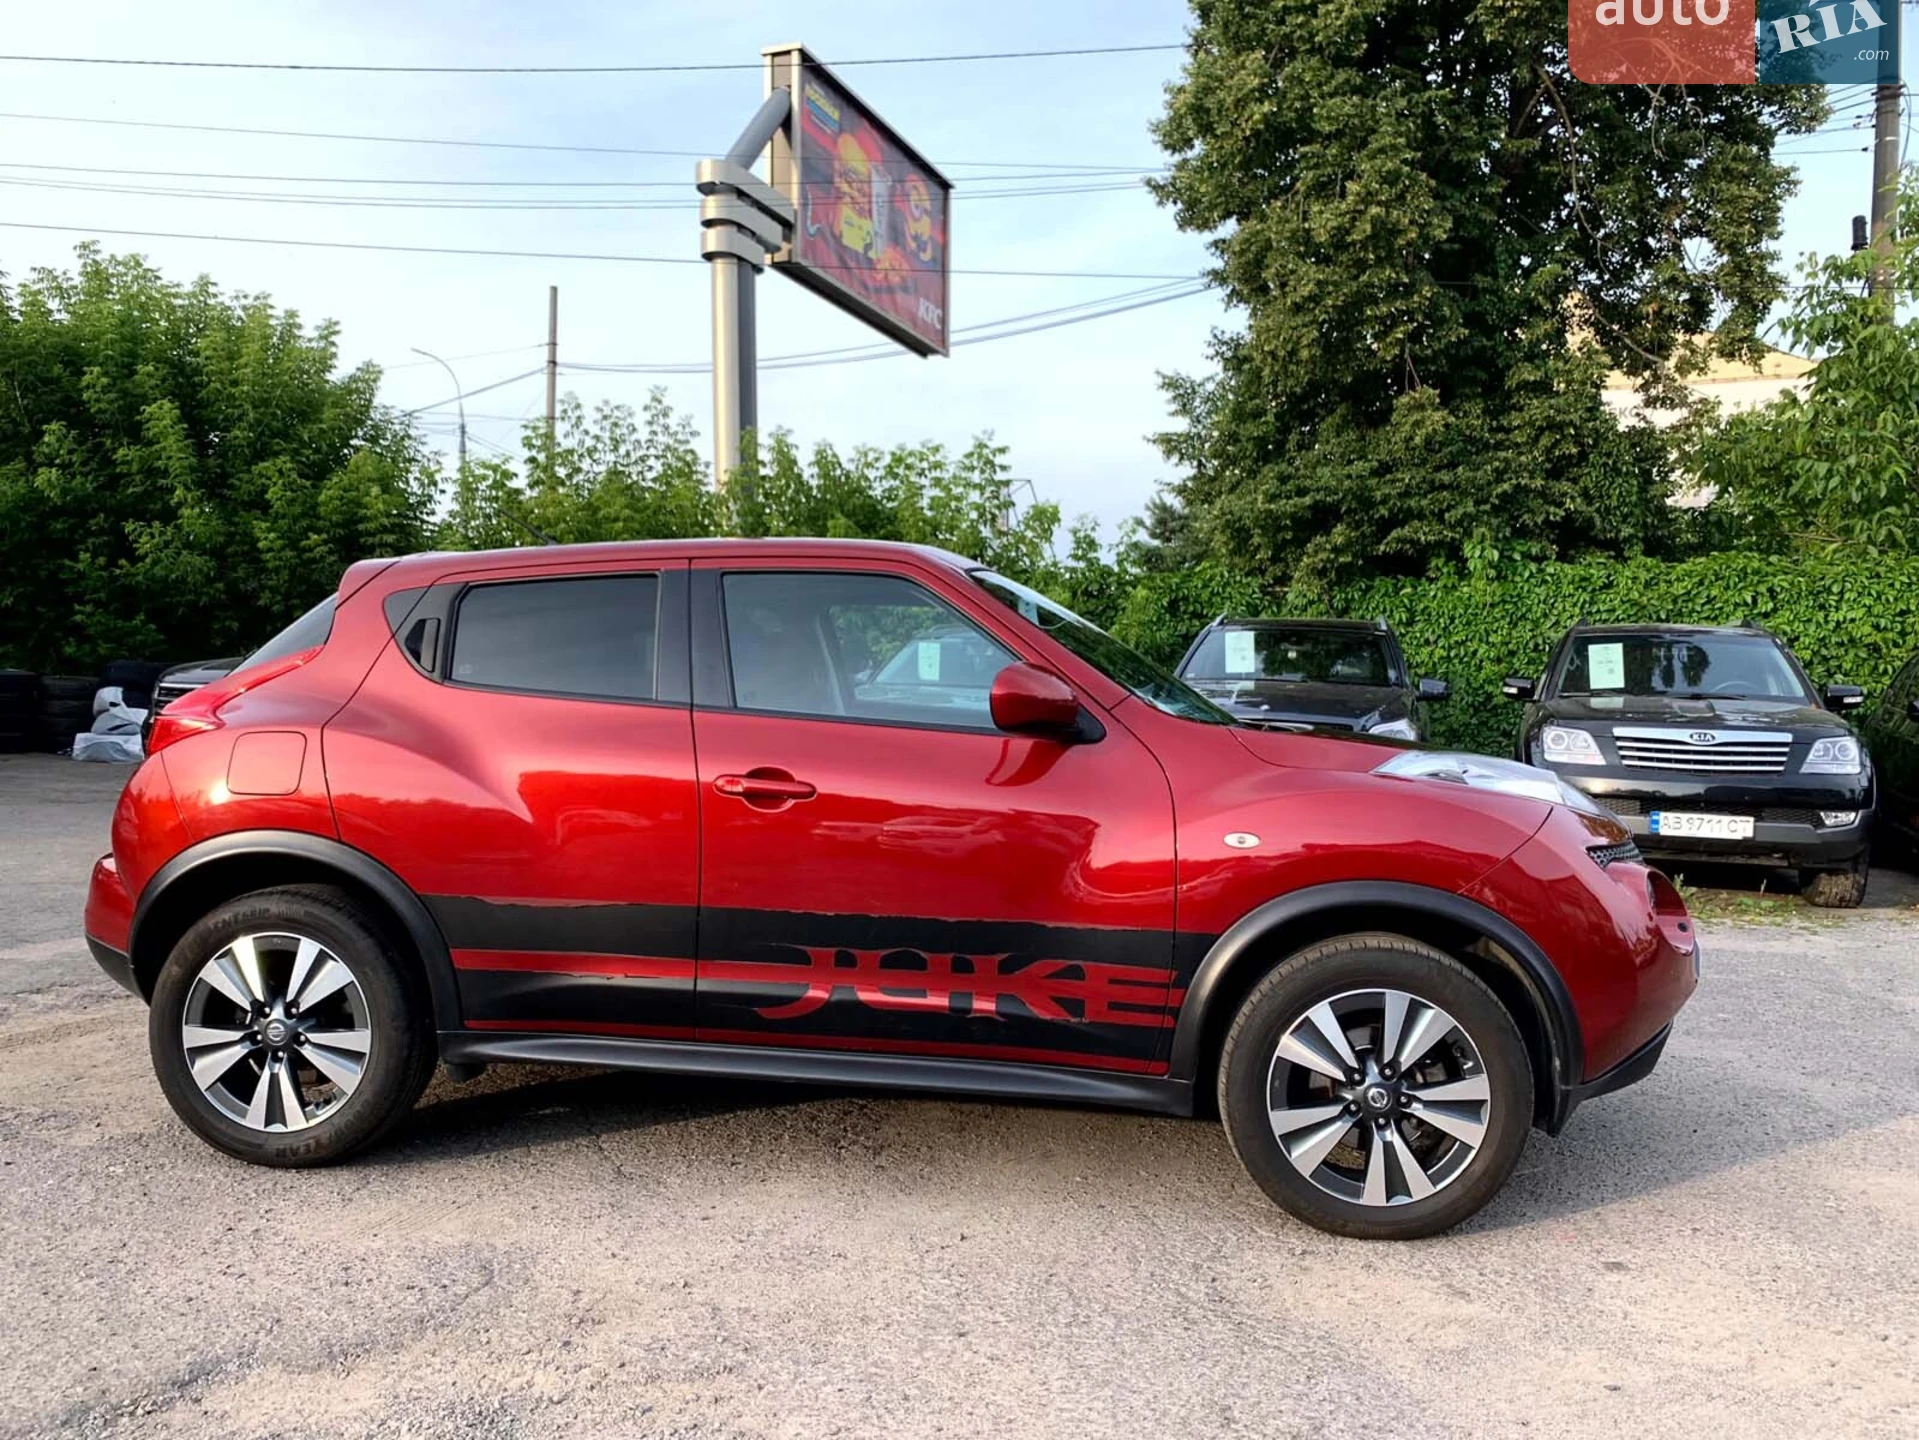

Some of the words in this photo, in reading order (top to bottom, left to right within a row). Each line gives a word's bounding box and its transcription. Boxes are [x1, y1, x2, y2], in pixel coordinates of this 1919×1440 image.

[918, 297, 943, 330] KFC
[1686, 816, 1724, 833] 9711
[753, 943, 1186, 1029] JUKE
